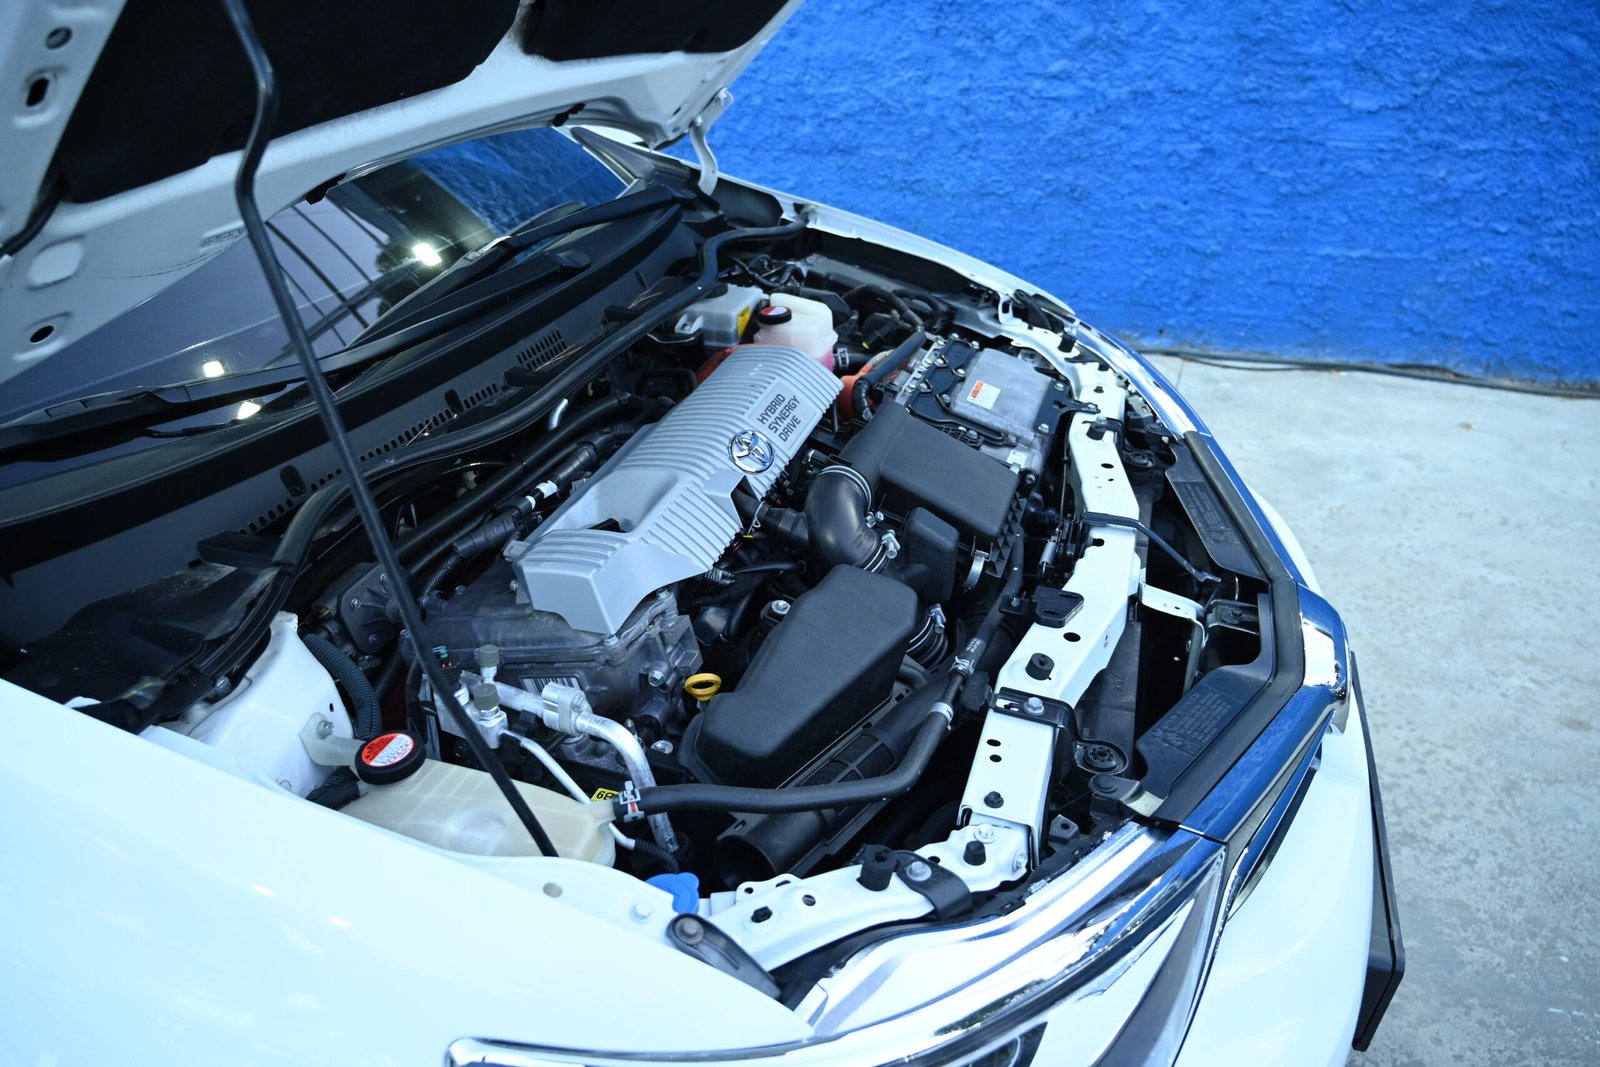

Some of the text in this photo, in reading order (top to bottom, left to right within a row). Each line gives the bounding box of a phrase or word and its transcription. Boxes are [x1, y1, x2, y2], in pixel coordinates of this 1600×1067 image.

[757, 393, 786, 425] HYBRID
[768, 395, 800, 434] SYNERGY
[778, 415, 801, 442] DRIVE
